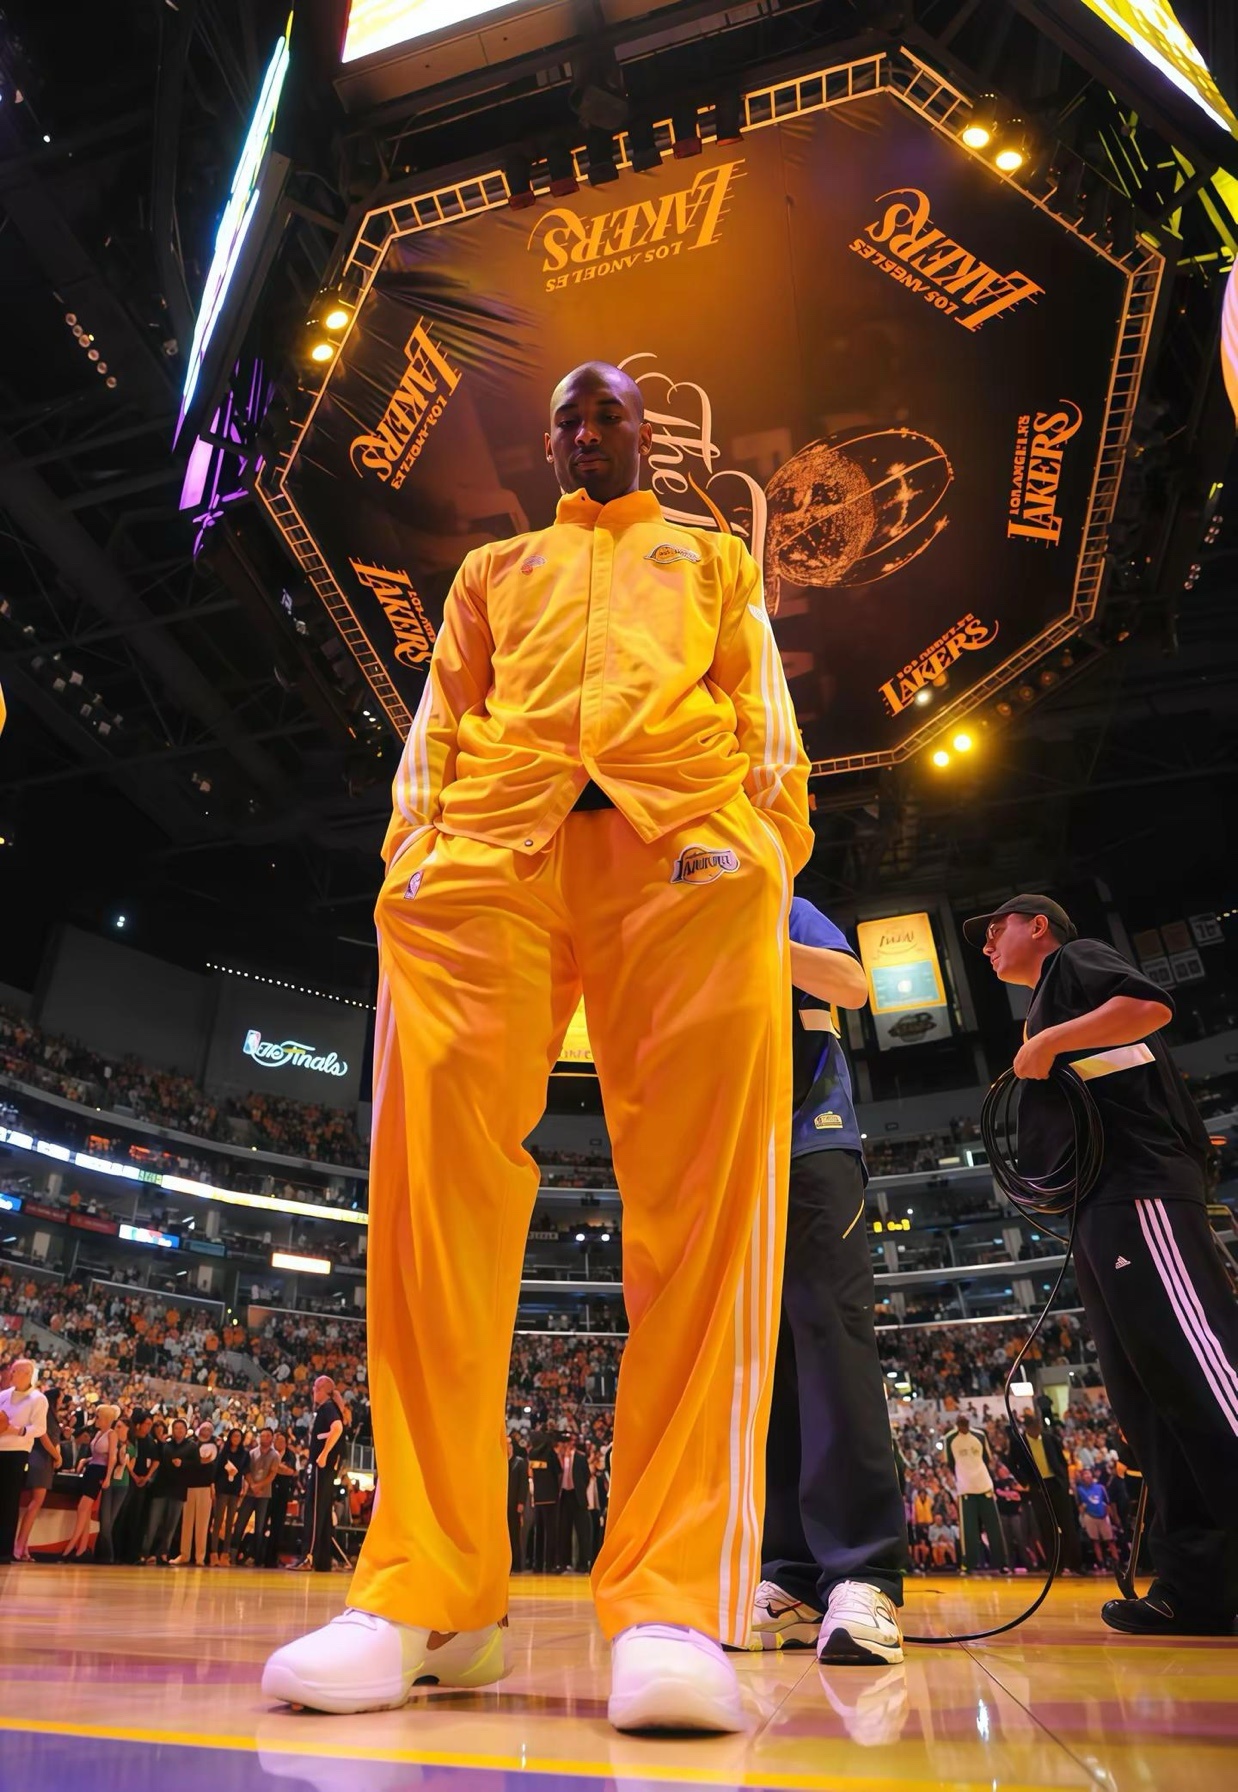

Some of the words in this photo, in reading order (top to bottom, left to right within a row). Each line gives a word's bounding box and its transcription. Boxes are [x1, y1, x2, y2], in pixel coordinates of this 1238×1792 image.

[527, 158, 748, 272] LAKERS
[643, 241, 683, 263] LOS
[849, 238, 931, 292] ANGELES
[864, 187, 1046, 332] LAKERS
[923, 290, 960, 315] LOS
[350, 315, 463, 482] LAKERS
[634, 371, 721, 495] The
[1007, 399, 1083, 549] LAKERS
[348, 556, 433, 671] LAKERS
[878, 618, 999, 717] LAKERS
[252, 1040, 348, 1077] Finals
